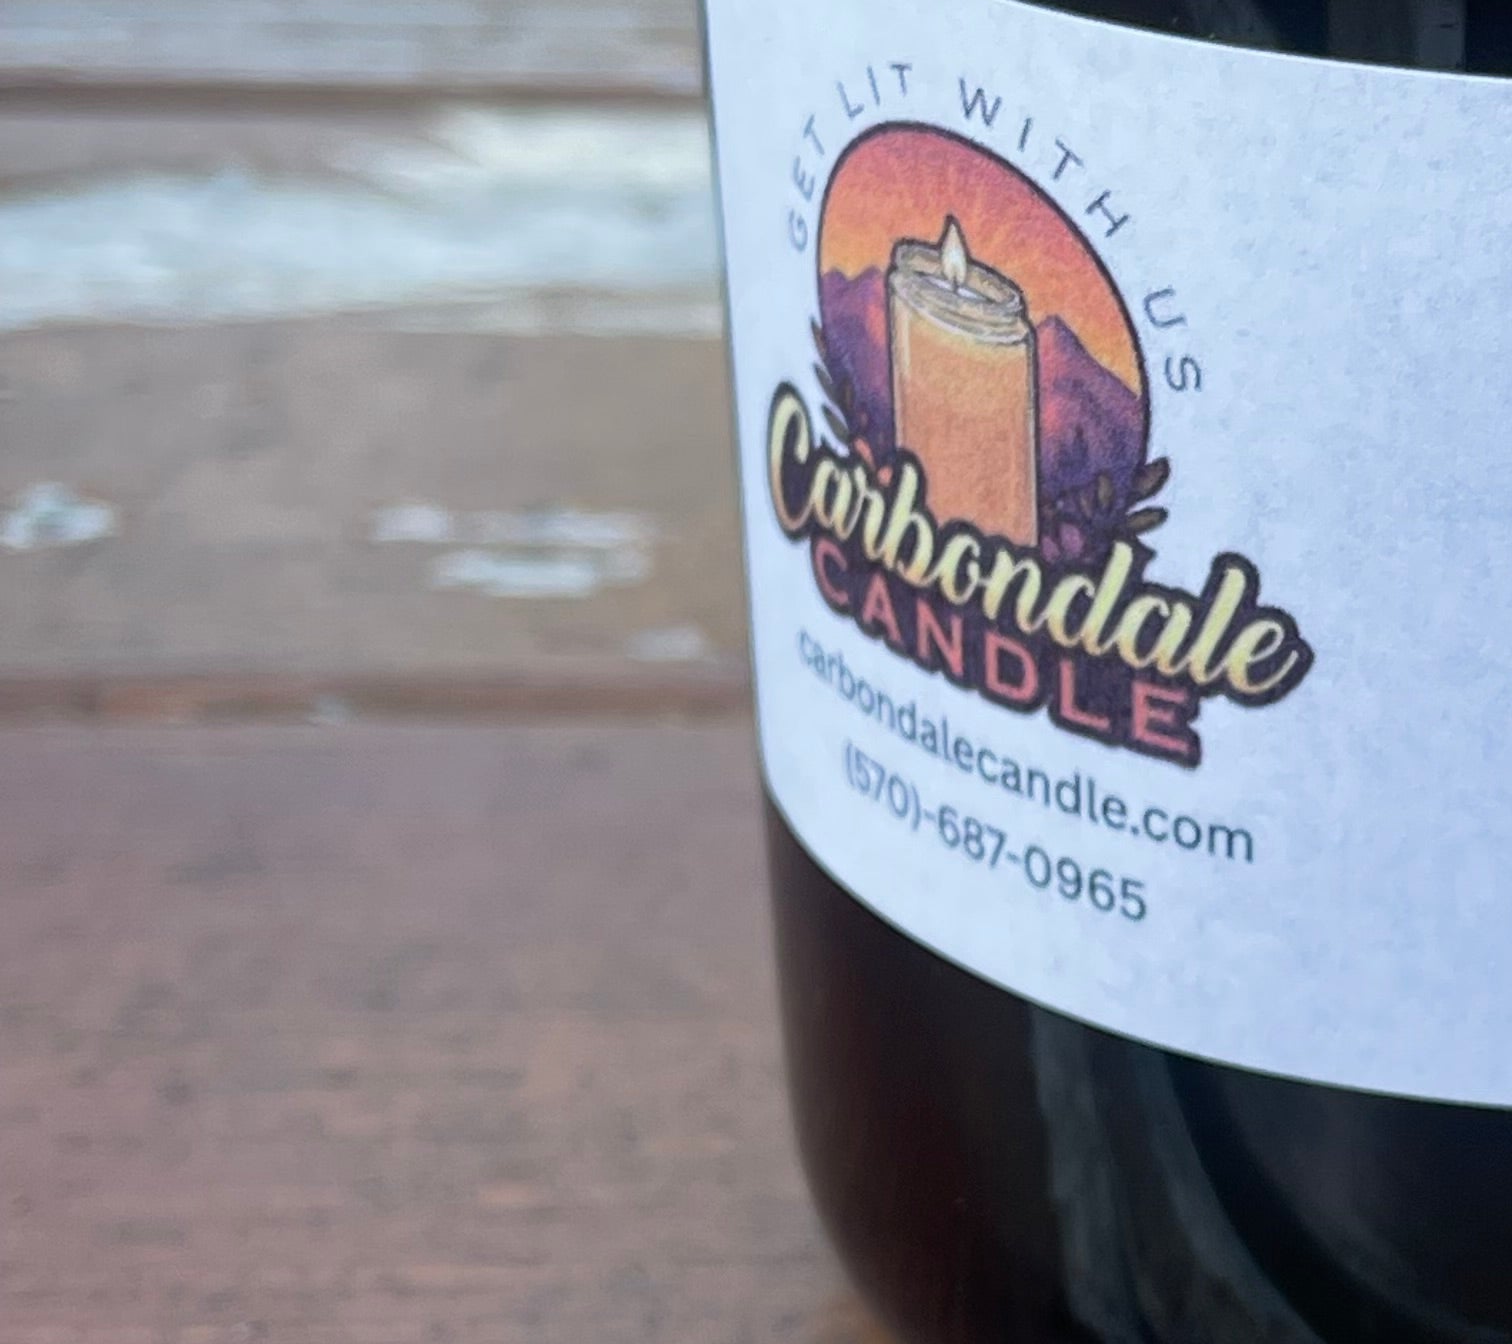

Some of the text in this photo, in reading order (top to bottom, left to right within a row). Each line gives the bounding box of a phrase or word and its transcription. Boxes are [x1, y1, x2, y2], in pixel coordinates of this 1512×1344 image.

[787, 62, 1201, 393] GET LIT WITH US
[768, 383, 1312, 705] Carbondale
[812, 540, 1198, 762] CANDLE
[798, 628, 1255, 862] carbondalecandle.com
[844, 741, 1148, 921] (570)-687-0965
